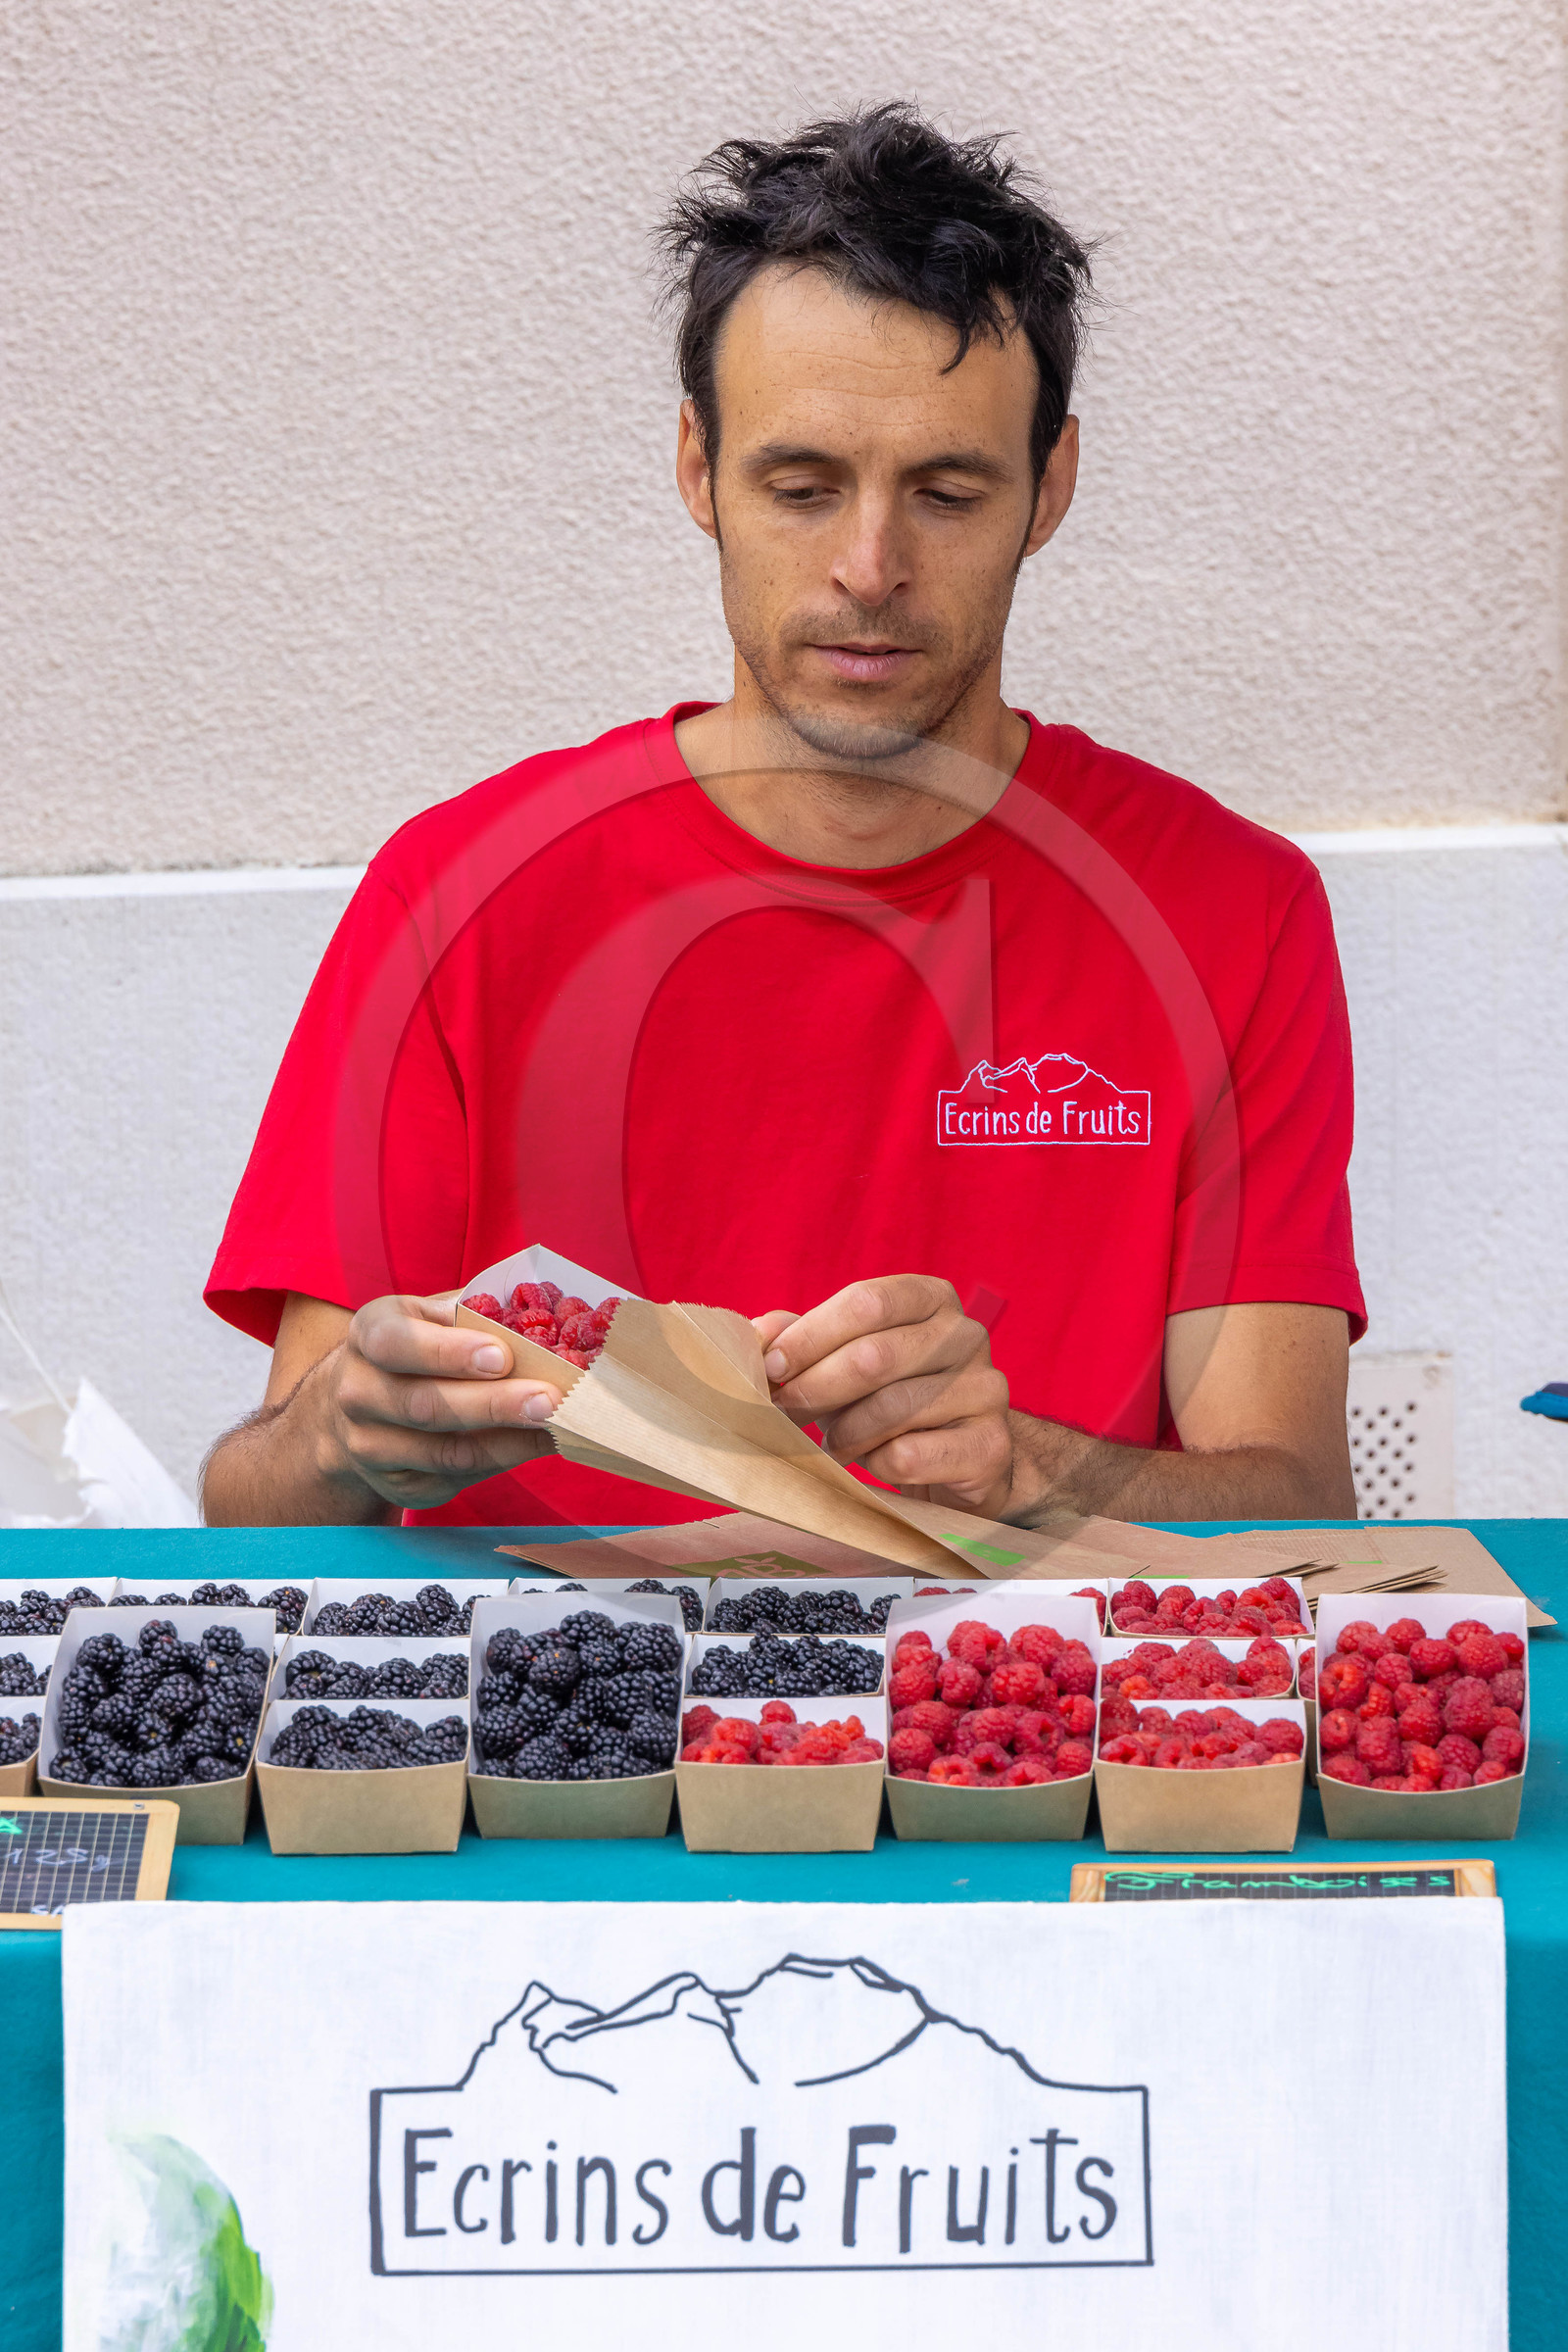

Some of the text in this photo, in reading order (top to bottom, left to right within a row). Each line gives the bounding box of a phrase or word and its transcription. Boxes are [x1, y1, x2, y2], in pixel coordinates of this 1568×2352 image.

[945, 1100, 1142, 1136] Ecrins de Fruits
[403, 2124, 1118, 2254] Ecrins de Fruits
